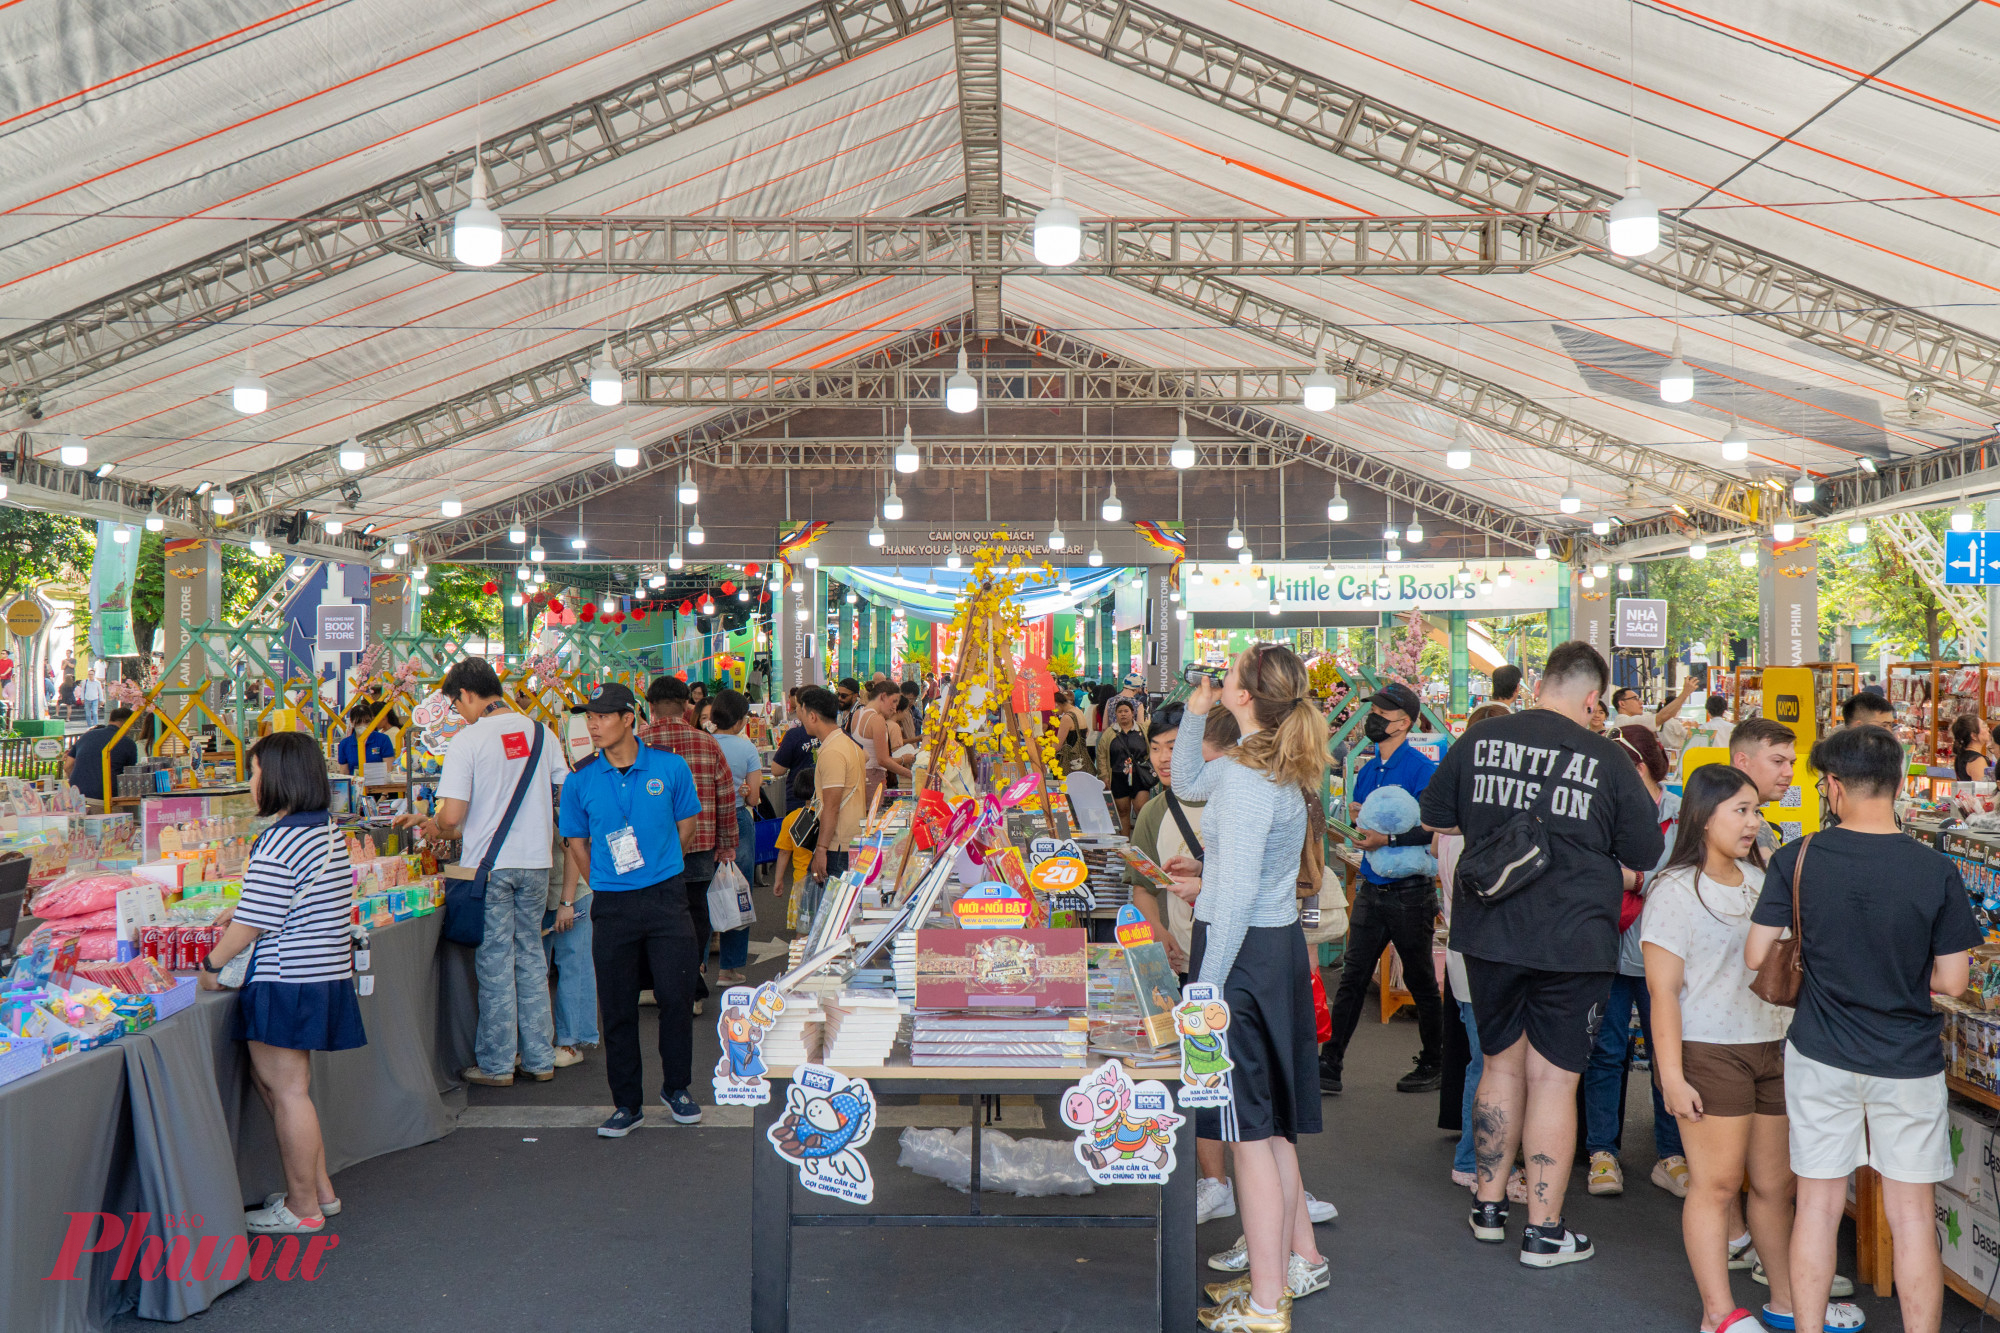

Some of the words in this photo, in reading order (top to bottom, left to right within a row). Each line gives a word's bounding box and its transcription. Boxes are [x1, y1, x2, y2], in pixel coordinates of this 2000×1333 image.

[998, 529, 1034, 541] HÁCH
[880, 545, 911, 555] THANK
[914, 545, 940, 555] YOU
[942, 545, 952, 555] &
[1028, 545, 1050, 554] NEW
[1269, 575, 1330, 601] Little
[1160, 575, 1169, 631] BOOKSTORE
[1626, 606, 1658, 621] NHÀ
[1791, 603, 1802, 637] PHIM
[324, 622, 354, 631] BOOK
[1589, 620, 1598, 645] PHIM
[1626, 621, 1658, 632] SÁCH
[324, 631, 354, 640] STORE
[1160, 632, 1169, 653] NAM
[794, 642, 803, 667] SÁCH
[1791, 639, 1802, 667] NAM
[1472, 774, 1593, 821] DIVISON
[1037, 866, 1078, 884] -20%
[958, 901, 979, 914] MỚI
[985, 899, 1003, 914] NỔI
[1005, 901, 1027, 915] BẬT
[1137, 1095, 1162, 1103] BOOK
[1126, 1163, 1140, 1171] CẦN
[818, 1175, 833, 1183] BẠN
[833, 1177, 849, 1187] CẦN
[1136, 1172, 1147, 1180] TÔI
[1148, 1172, 1161, 1180] NHÉ
[805, 1179, 817, 1189] GỌI
[818, 1183, 841, 1194] CHÚNG
[842, 1188, 853, 1197] TÔI
[853, 1192, 868, 1201] NHÉ
